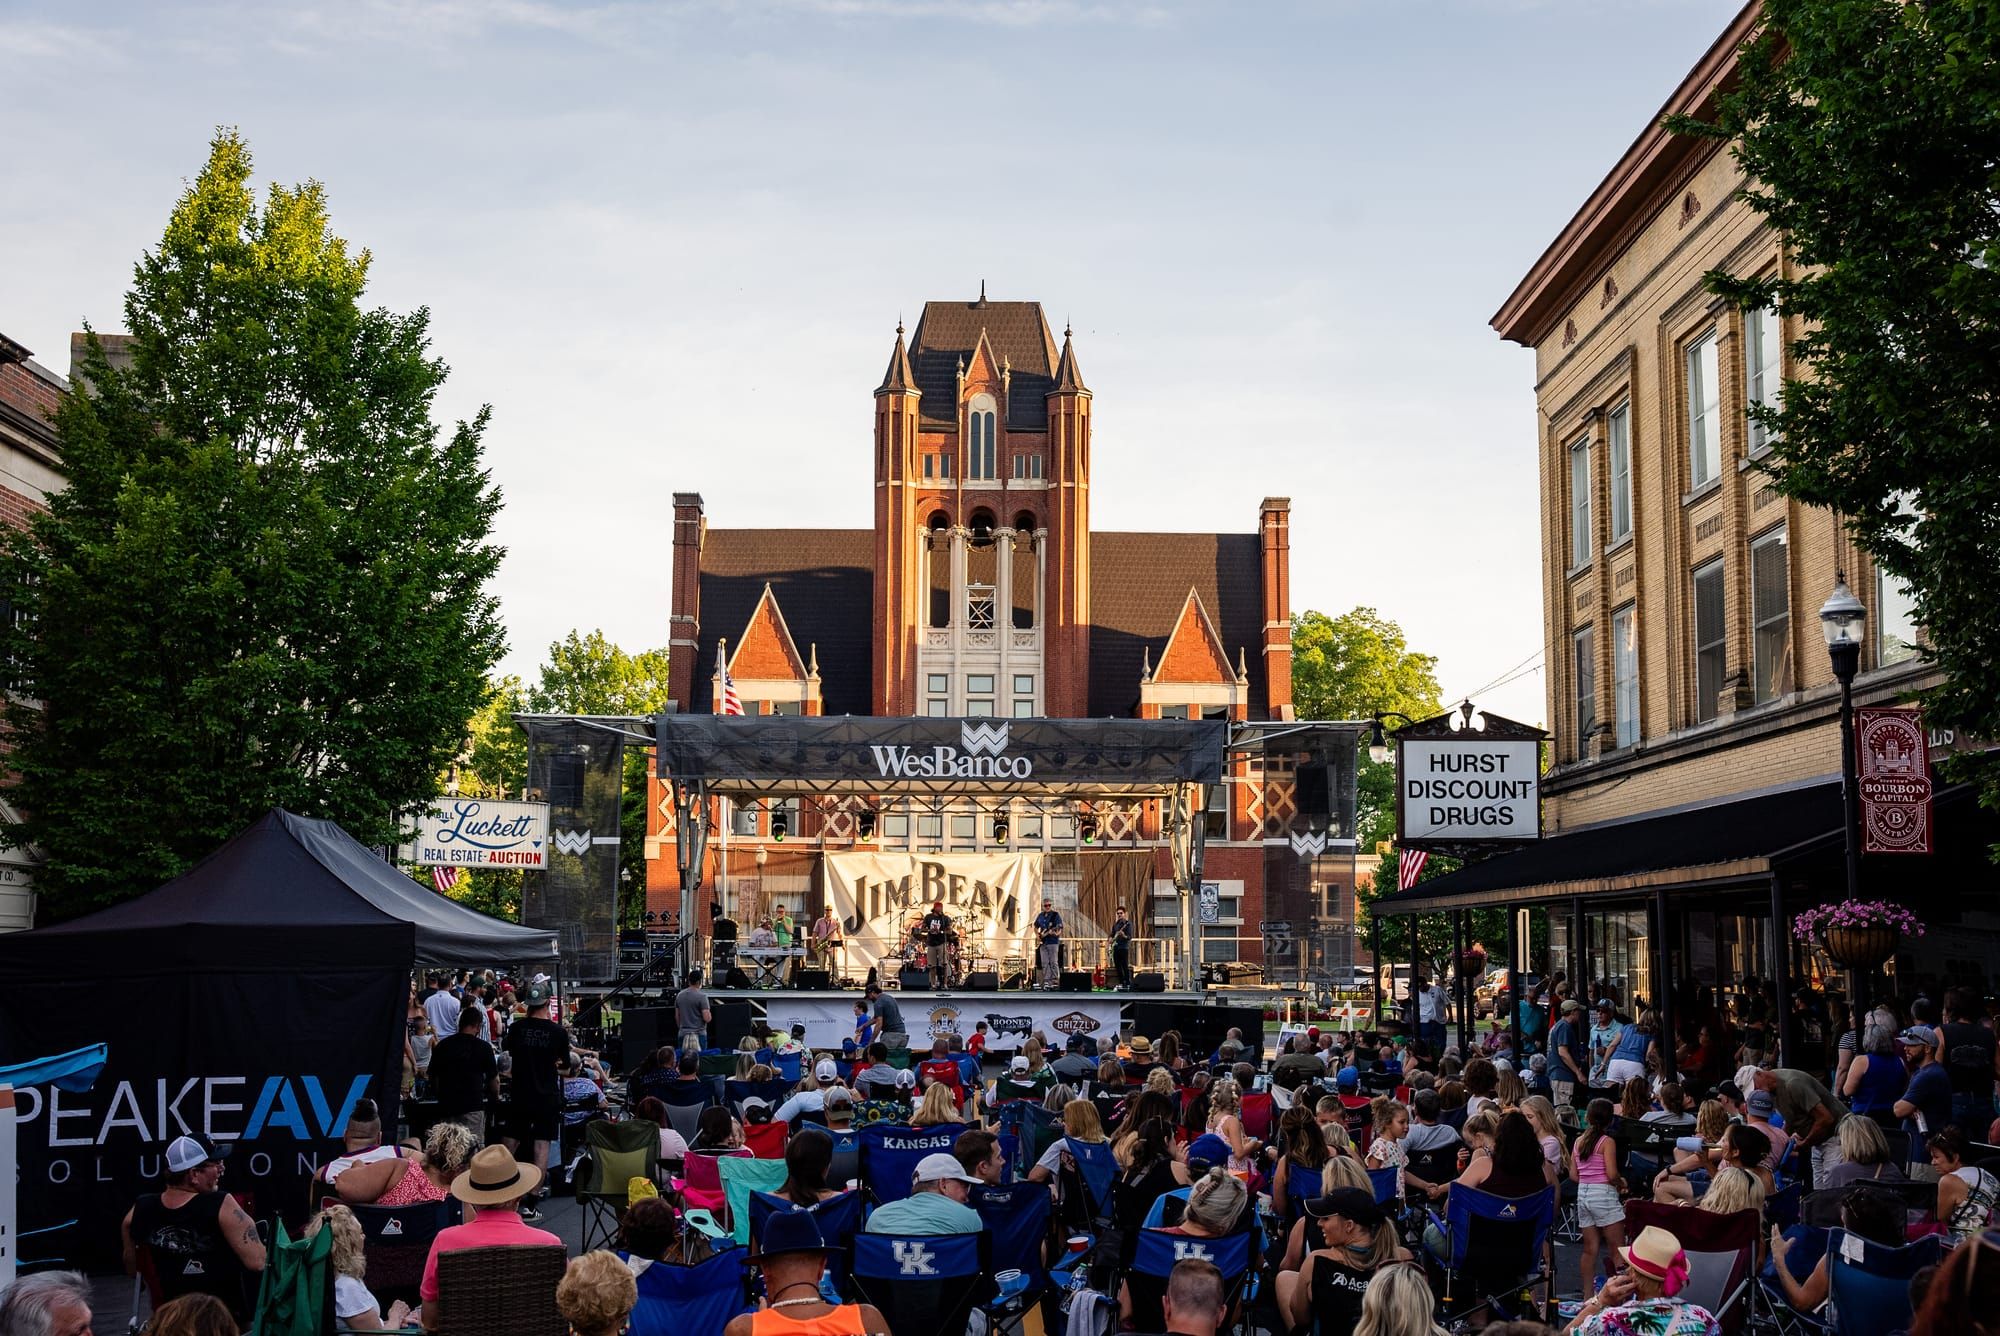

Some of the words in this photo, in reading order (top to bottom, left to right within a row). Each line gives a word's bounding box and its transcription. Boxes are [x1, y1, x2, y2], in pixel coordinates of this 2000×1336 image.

[1870, 725, 1914, 745] BARDSTOWN
[870, 746, 1033, 779] WesBanco
[1430, 753, 1510, 773] HURST
[1408, 780, 1532, 799] DISCOUNT
[1865, 783, 1925, 794] BOURBON
[1874, 794, 1917, 803] CAPITAL
[436, 811, 454, 820] BILL
[1430, 806, 1514, 826] DRUGS
[1892, 812, 1902, 824] B
[437, 801, 538, 850] Luckett
[1877, 821, 1915, 839] DISTRICT
[424, 848, 447, 862] REAL
[489, 851, 542, 865] AUCTION
[843, 875, 913, 936] JIM
[920, 861, 1018, 935] BEAM
[993, 1018, 1031, 1026] BOONE'S
[1057, 1020, 1096, 1030] GRIZZLY
[883, 1135, 951, 1150] KANSAS
[892, 1240, 936, 1275] UK
